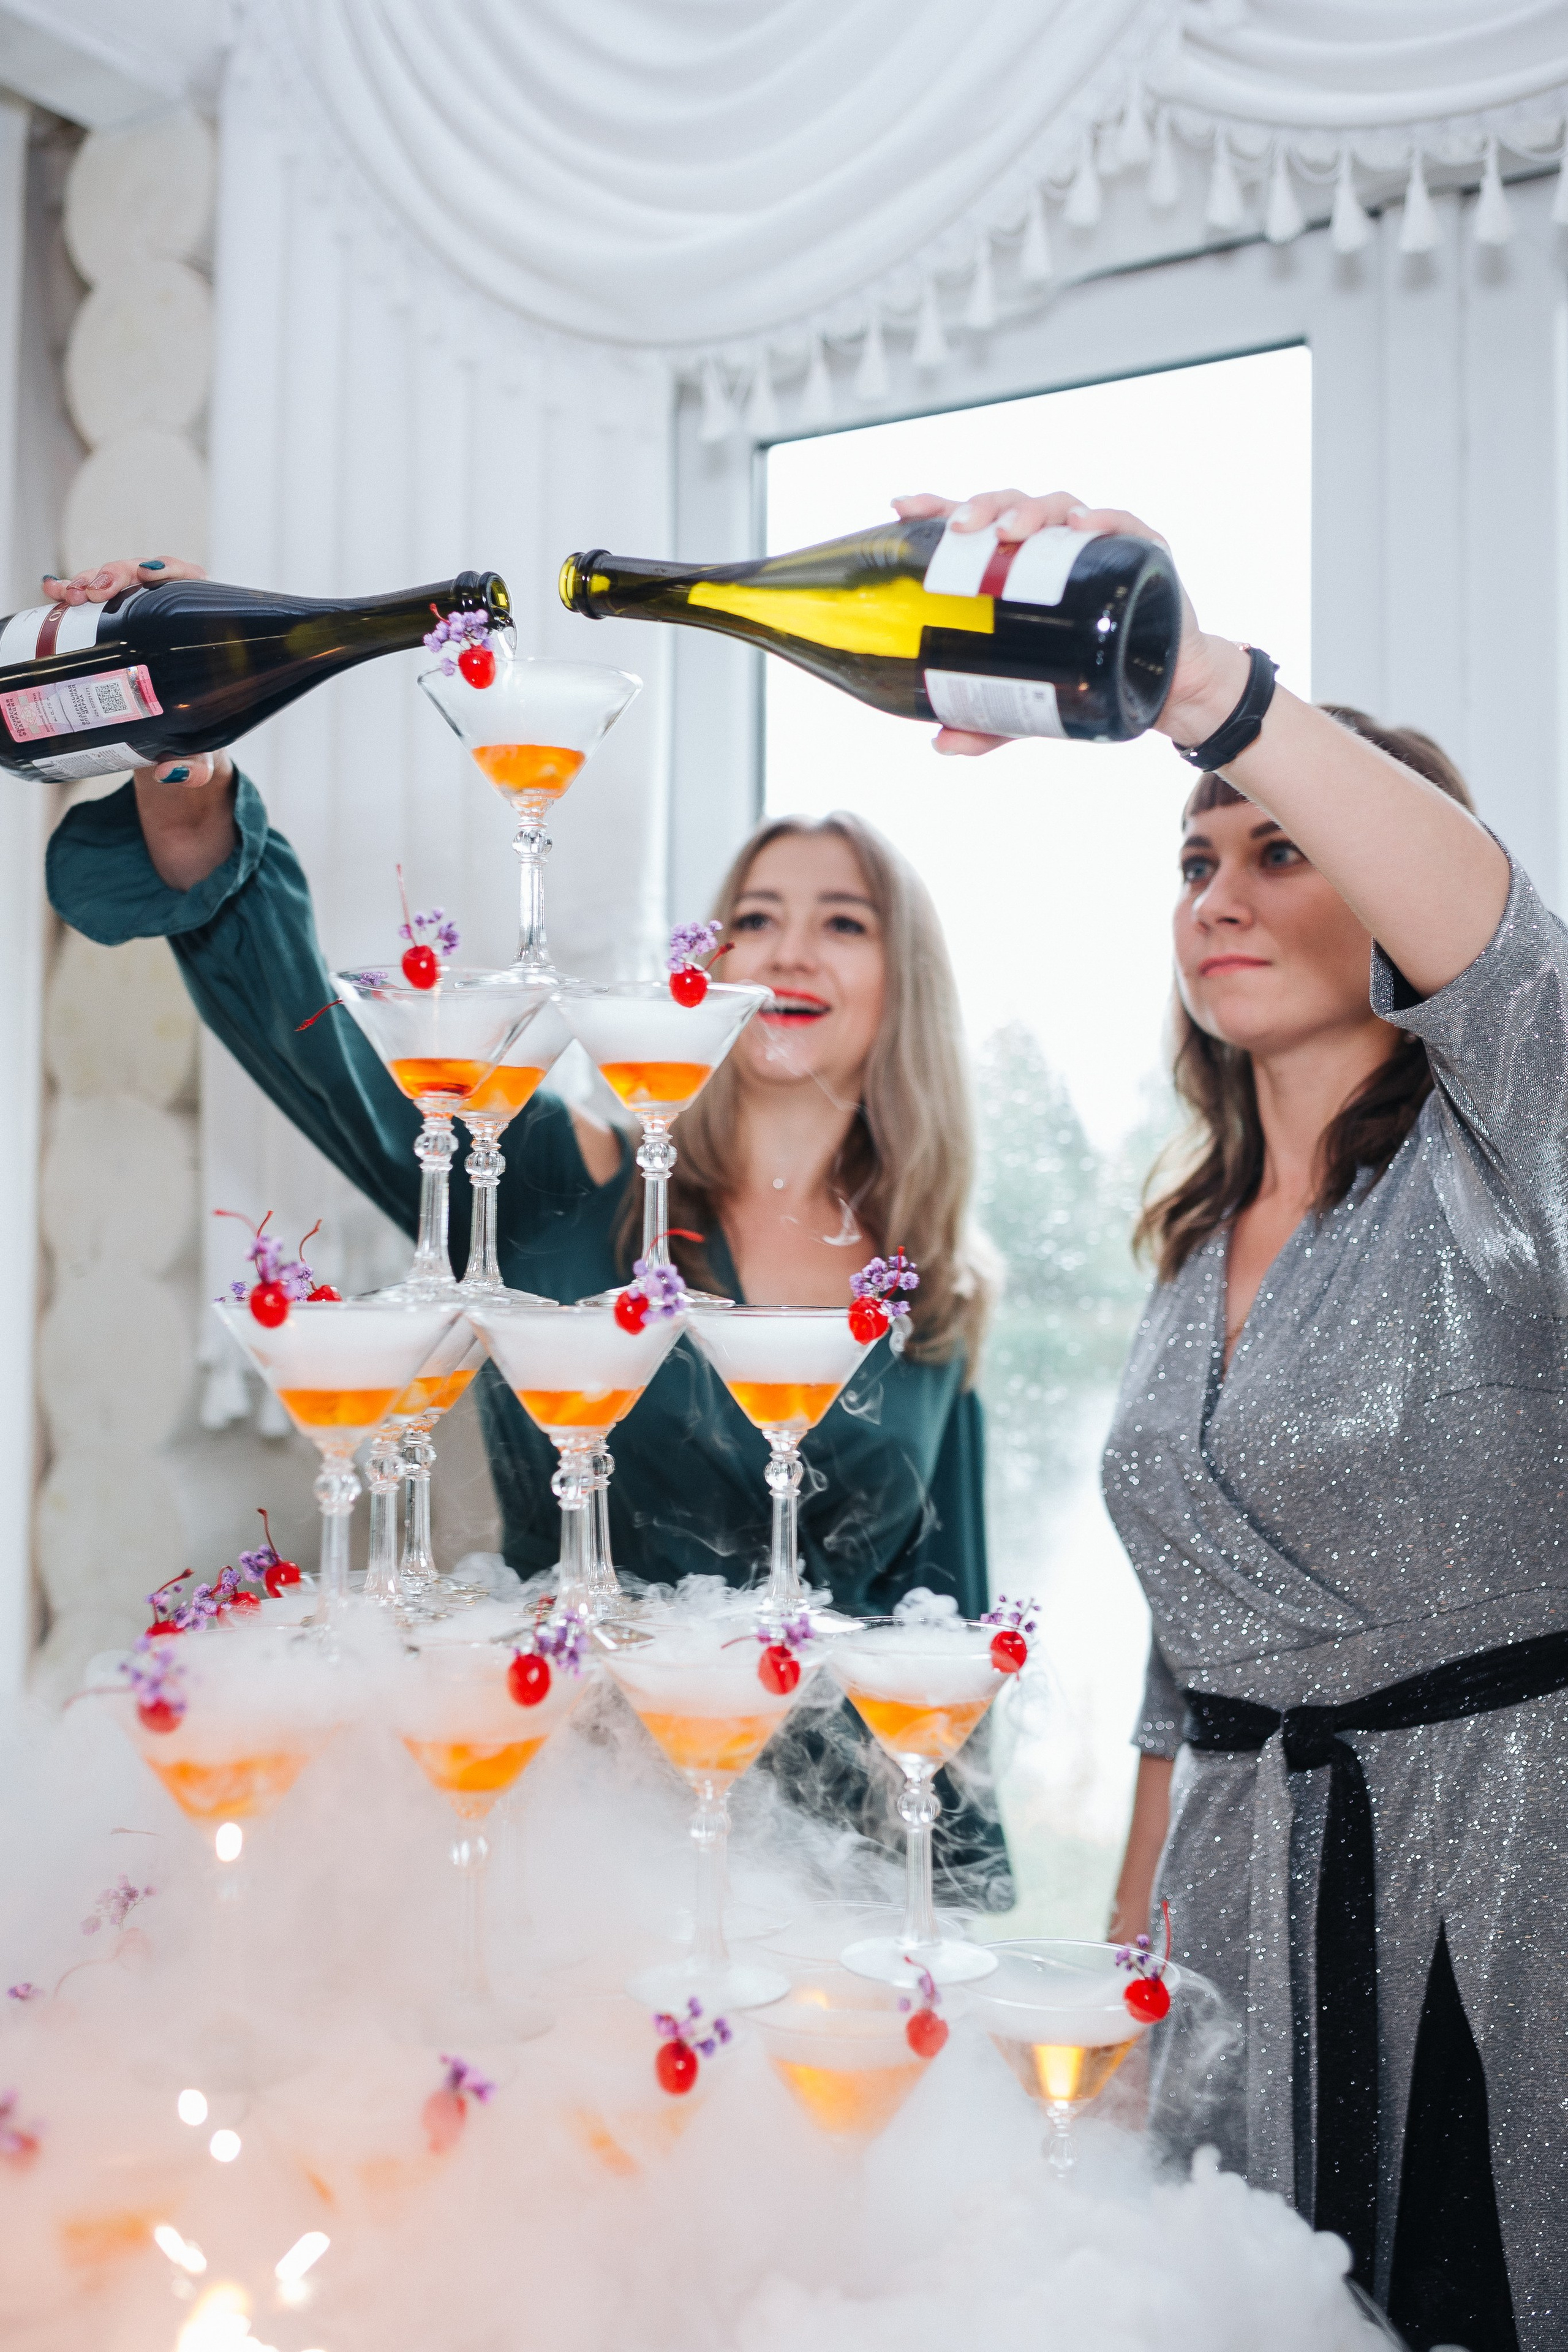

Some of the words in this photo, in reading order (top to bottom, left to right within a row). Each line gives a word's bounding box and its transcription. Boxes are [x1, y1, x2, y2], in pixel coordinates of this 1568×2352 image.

[6, 699, 23, 737] РОССИЙСКАЯ
[10, 698, 27, 736] ФЕДЕРАЦИЯ
[68, 685, 86, 725] ФЕДЕРАЛЬНАЯ
[72, 684, 90, 725] СПЕЦИАЛЬНАЯ
[80, 695, 89, 714] МАРКА
